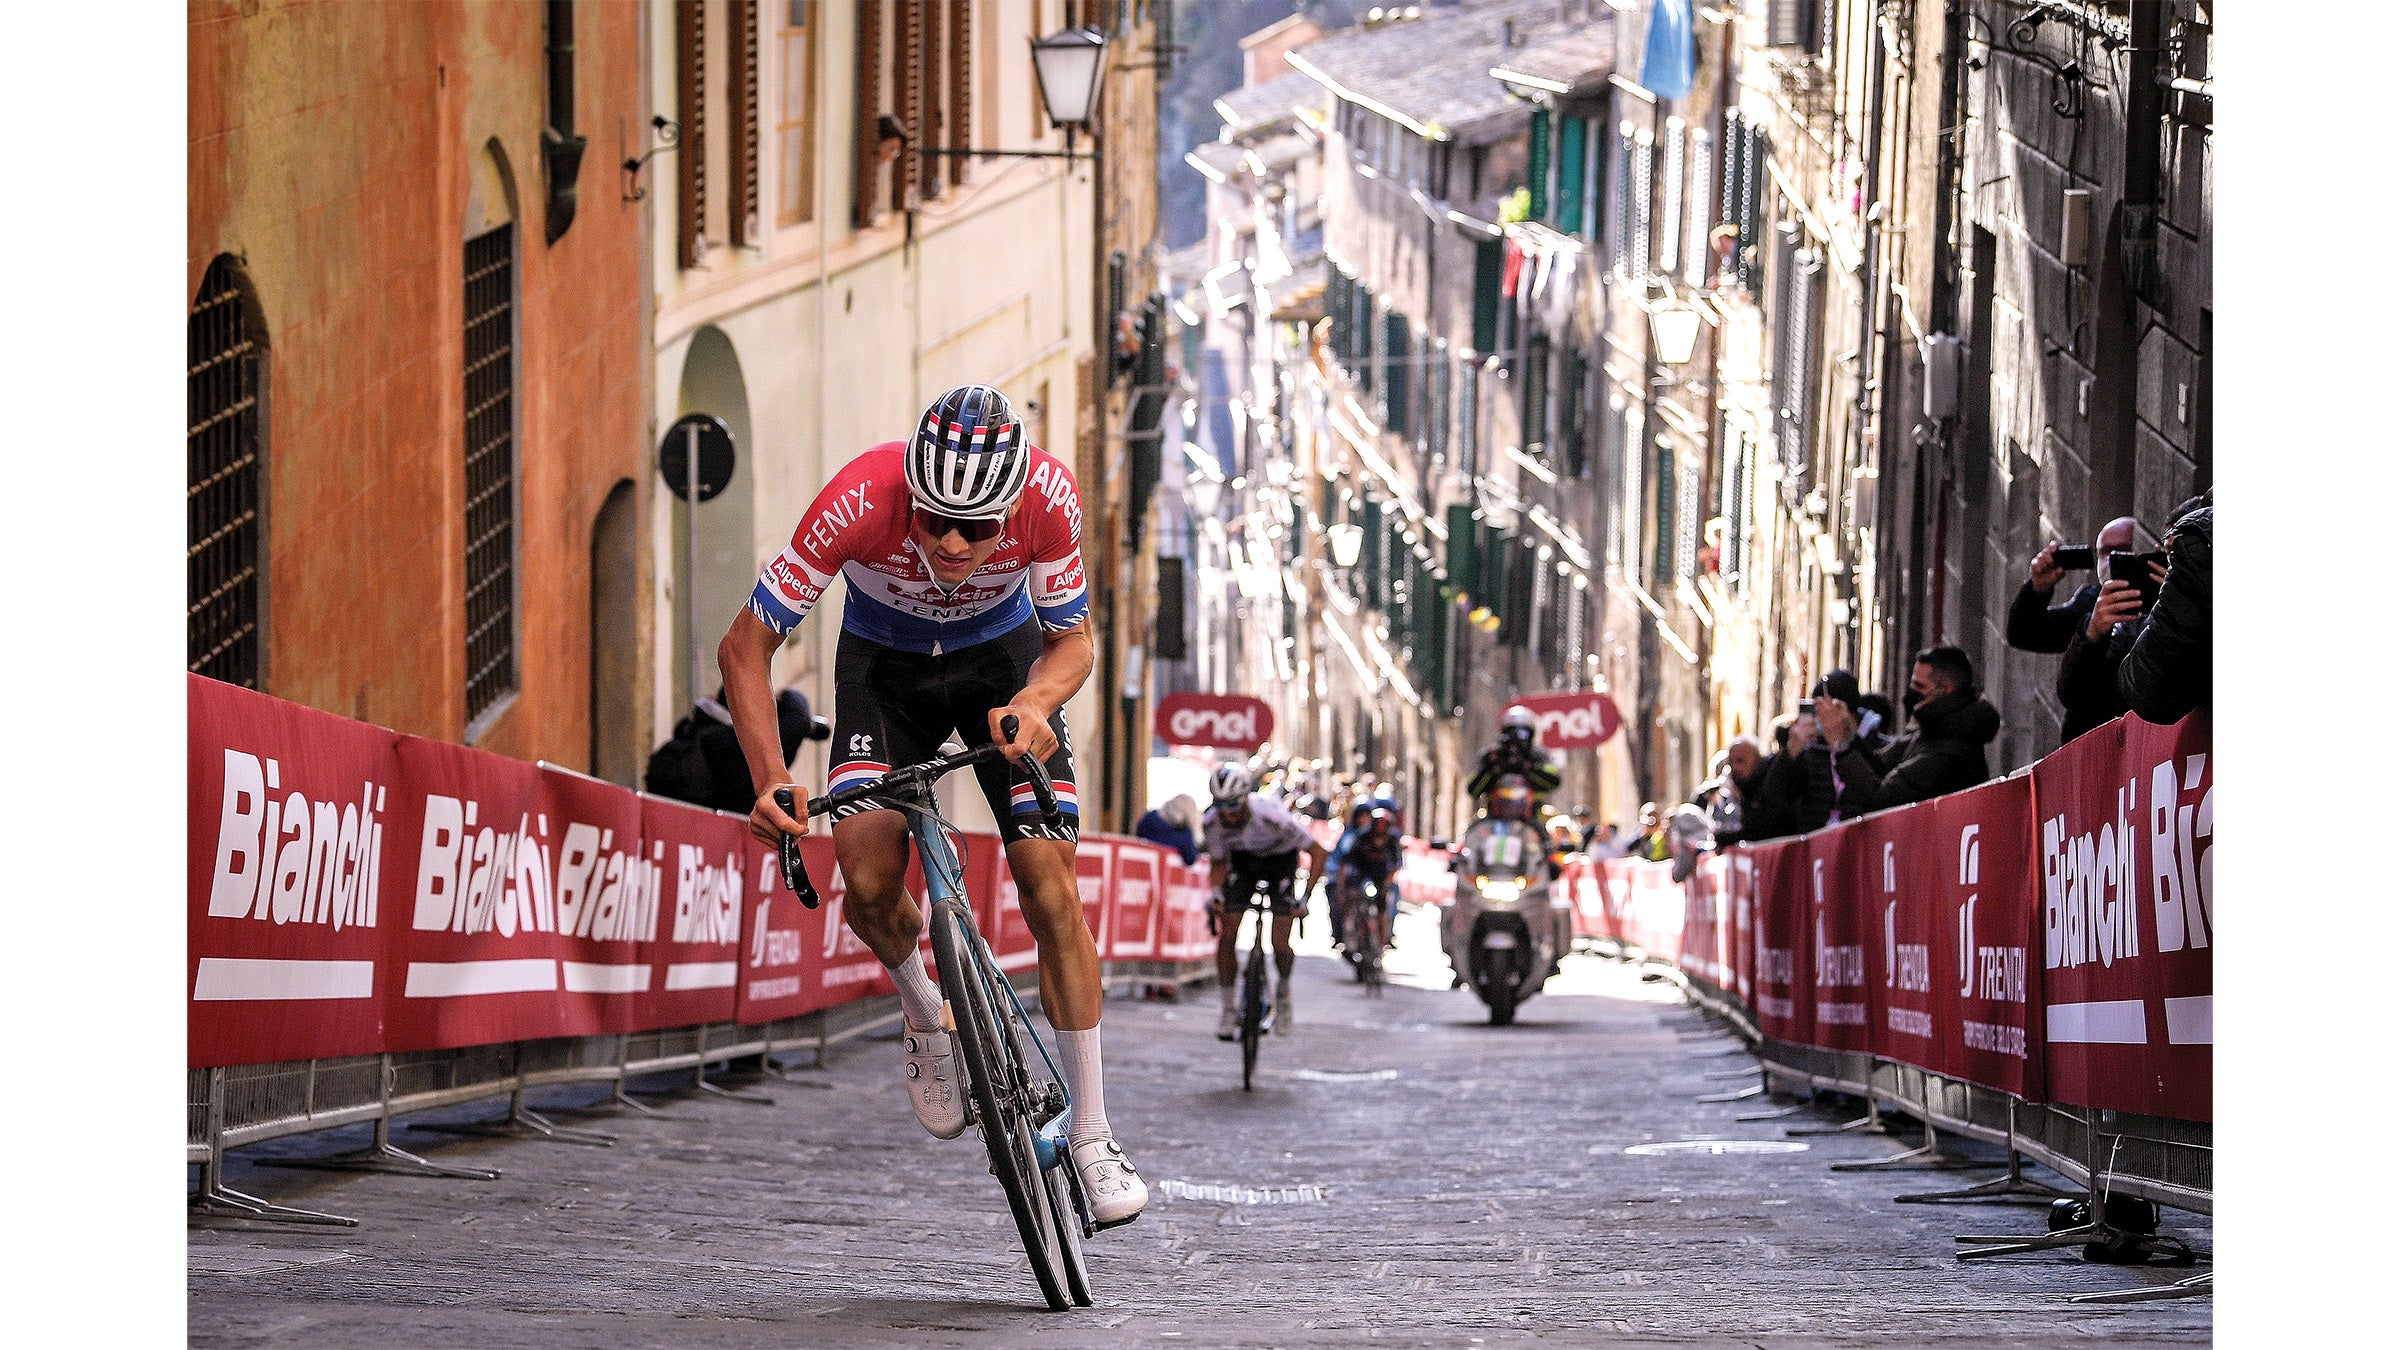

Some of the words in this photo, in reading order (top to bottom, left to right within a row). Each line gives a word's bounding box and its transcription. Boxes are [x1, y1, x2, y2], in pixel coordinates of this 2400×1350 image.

[1028, 460, 1082, 546] Alpecin
[774, 560, 819, 600] Alpecin
[1036, 592, 1067, 601] CAFFEINE
[1170, 706, 1257, 741] enel
[1534, 699, 1604, 739] nel
[208, 748, 386, 933] Bianchi
[412, 794, 554, 938] Bianchi
[2043, 776, 2139, 969] Bianchi
